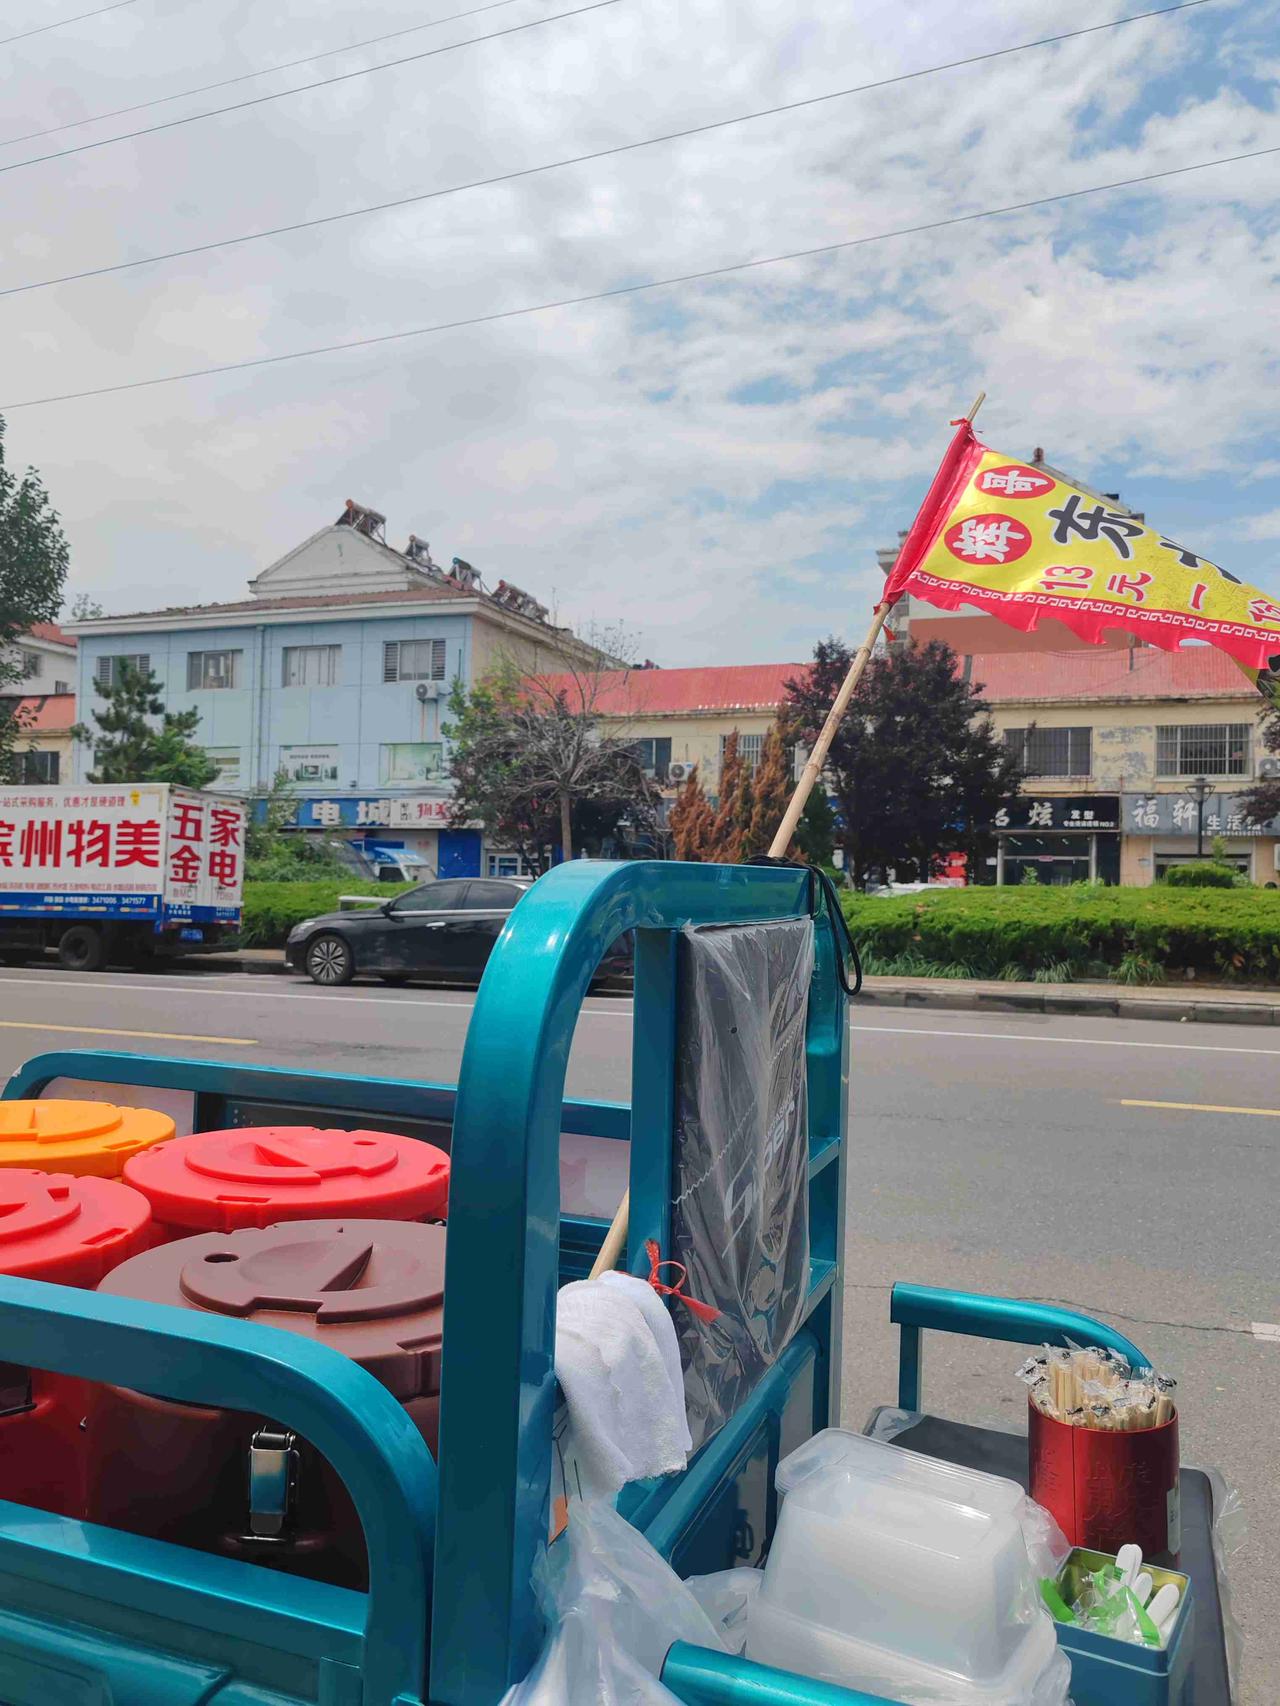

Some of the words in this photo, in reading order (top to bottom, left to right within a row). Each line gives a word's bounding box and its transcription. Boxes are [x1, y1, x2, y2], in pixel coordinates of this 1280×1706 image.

[169, 803, 204, 883] 五金
[208, 808, 241, 888] 家电
[1131, 798, 1198, 830] 福轩
